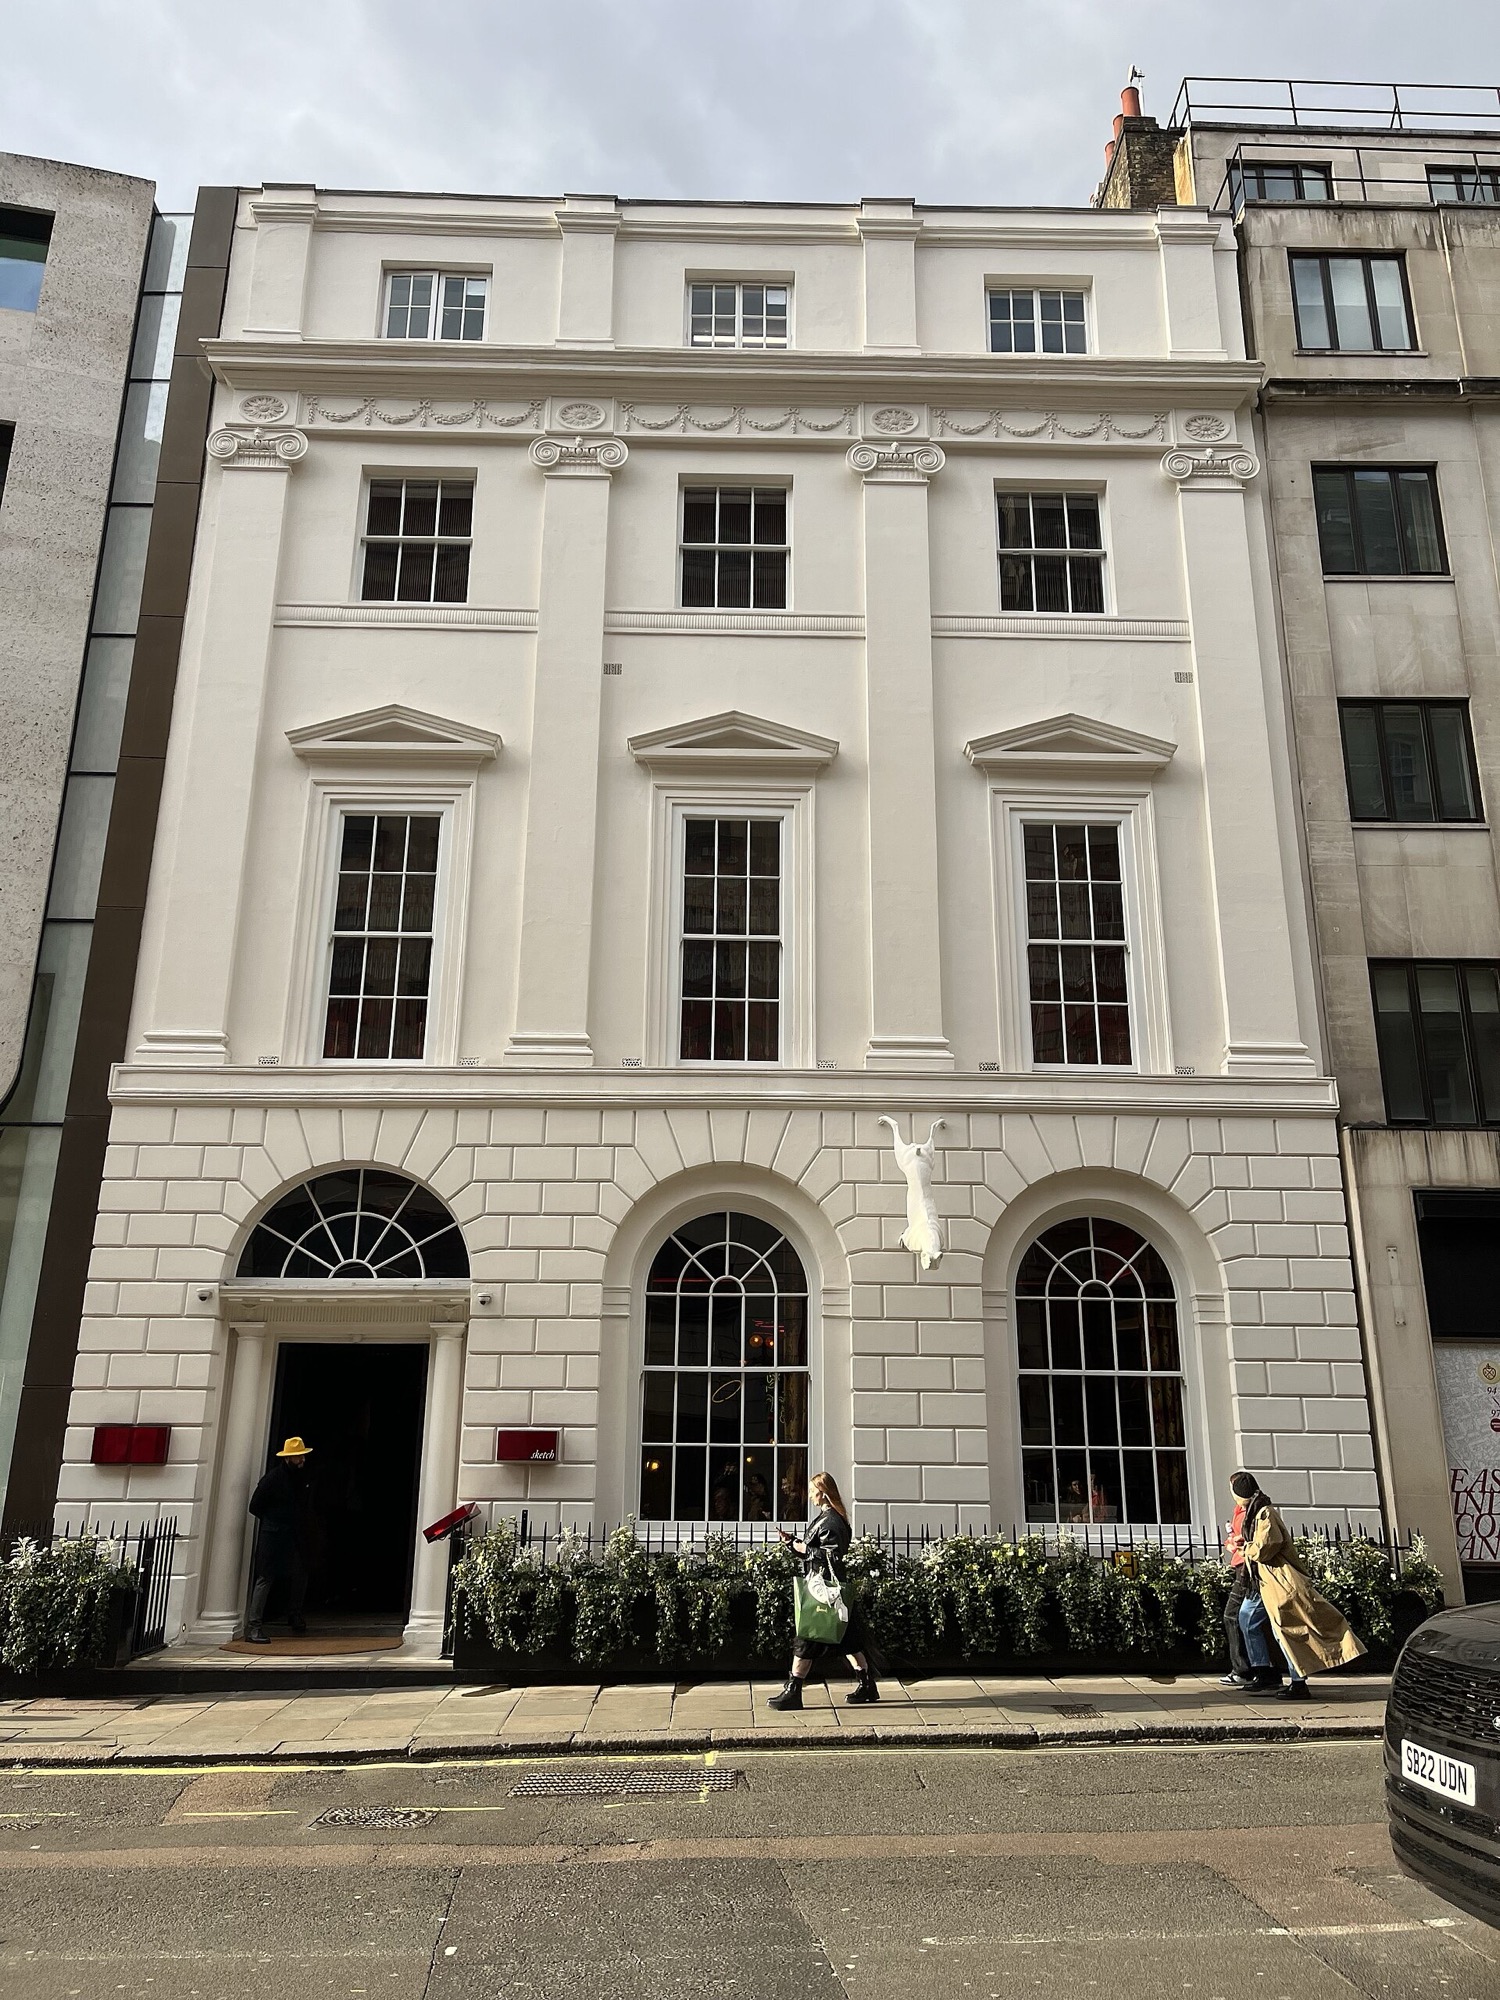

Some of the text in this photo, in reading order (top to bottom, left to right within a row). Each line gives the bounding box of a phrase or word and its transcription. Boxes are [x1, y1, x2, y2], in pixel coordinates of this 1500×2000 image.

[1487, 1386, 1497, 1395] 94
[530, 1449, 555, 1459] sketch
[1456, 1513, 1500, 1538] CO
[1407, 1746, 1467, 1795] SB22 UDN
